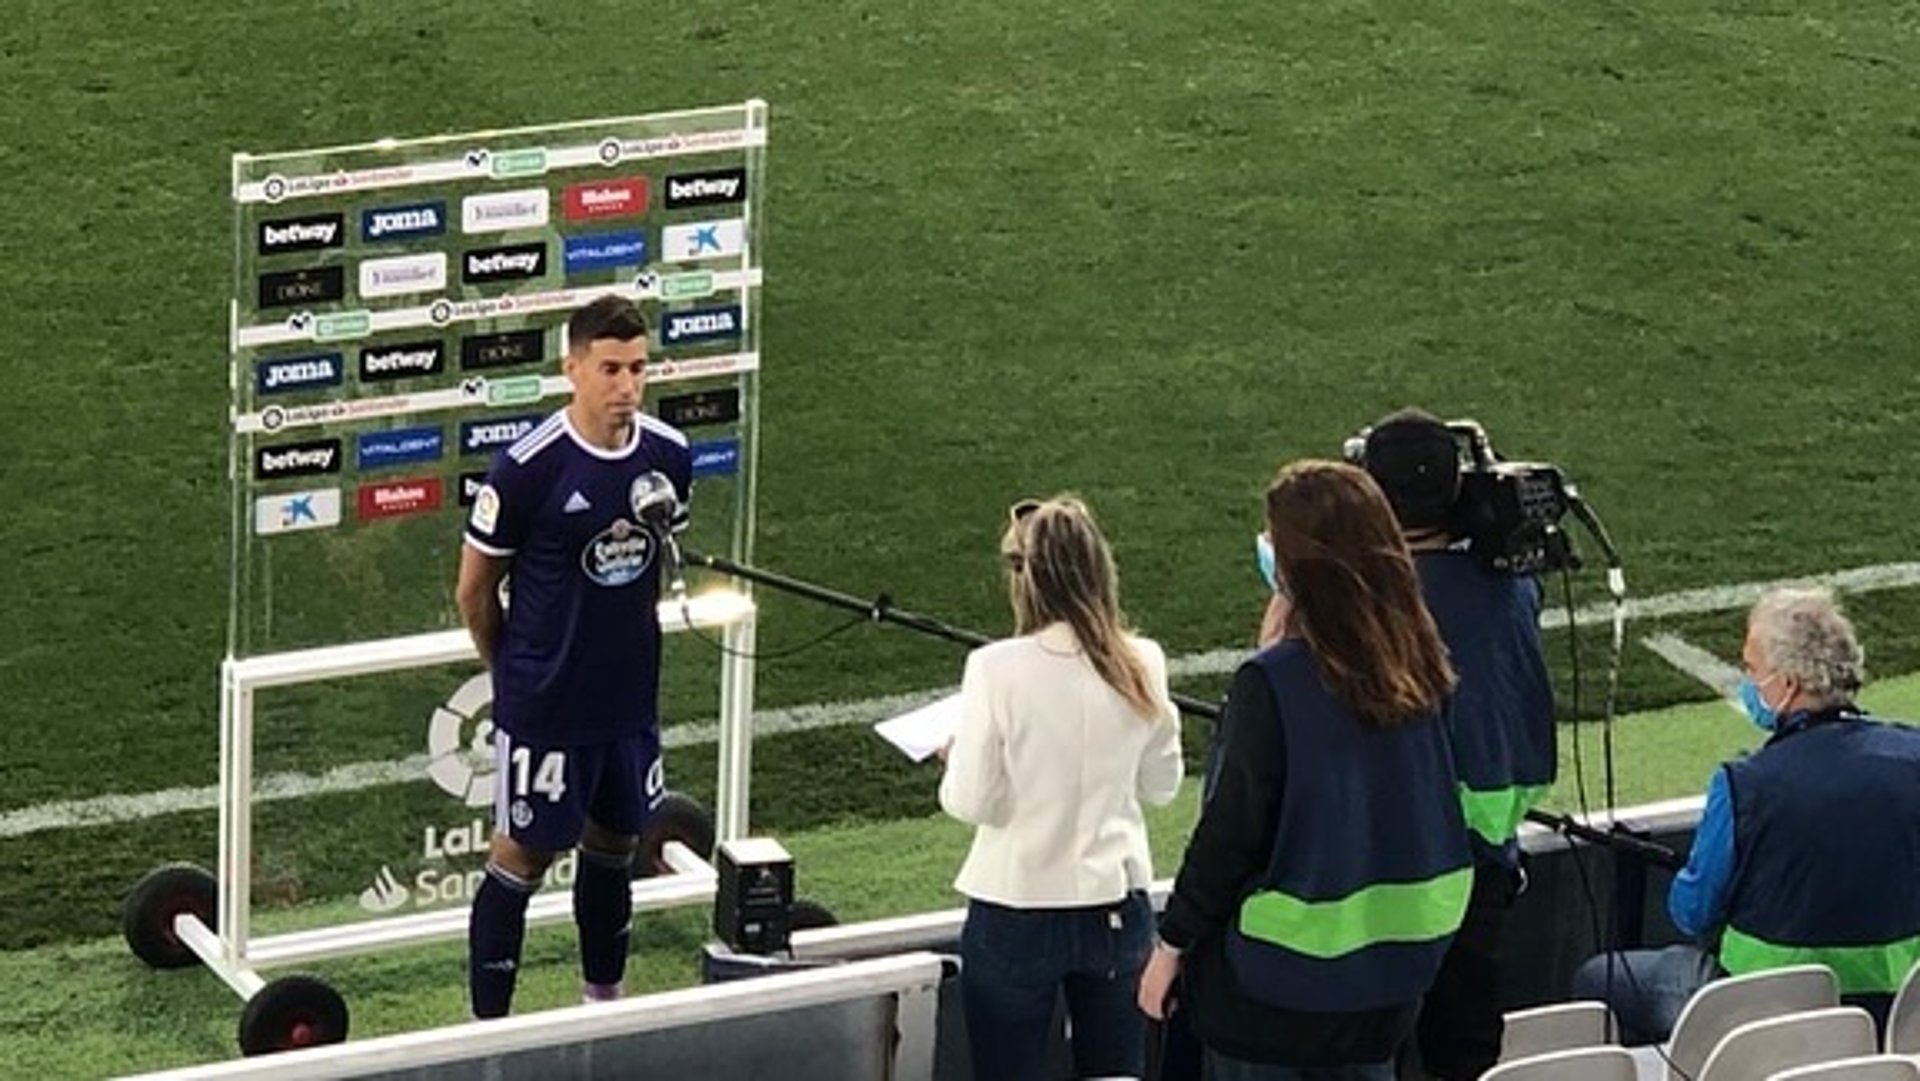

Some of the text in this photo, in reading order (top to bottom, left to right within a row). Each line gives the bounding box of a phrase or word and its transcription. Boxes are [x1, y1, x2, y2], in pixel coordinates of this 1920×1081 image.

[670, 177, 740, 199] betway
[264, 221, 337, 245] betway
[468, 252, 541, 275] betway
[365, 349, 437, 372] betway
[262, 447, 335, 471] betway
[511, 747, 566, 802] 14
